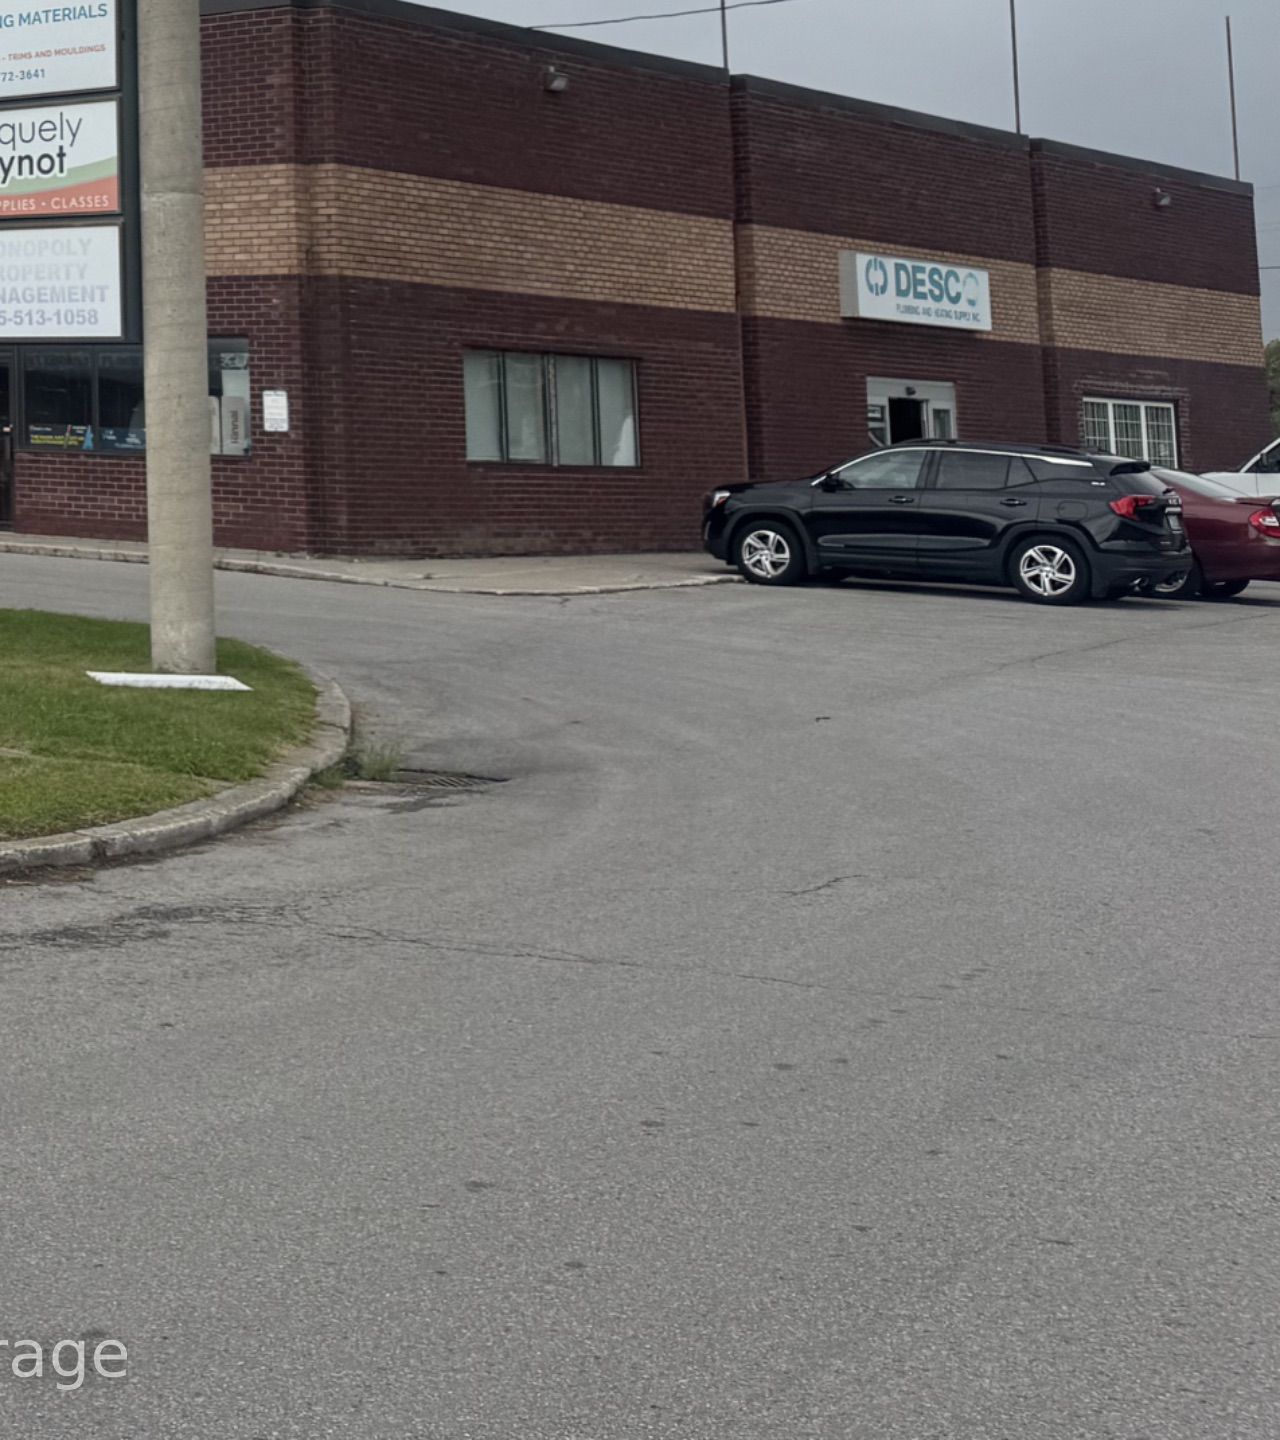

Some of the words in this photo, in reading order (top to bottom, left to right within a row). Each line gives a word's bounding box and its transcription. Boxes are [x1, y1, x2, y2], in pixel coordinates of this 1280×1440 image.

[18, 3, 108, 26] MATERIALS
[8, 51, 32, 62] TRIMS
[34, 49, 52, 59] AND
[54, 44, 106, 56] MOULDINGS
[50, 195, 109, 210] CLASSES
